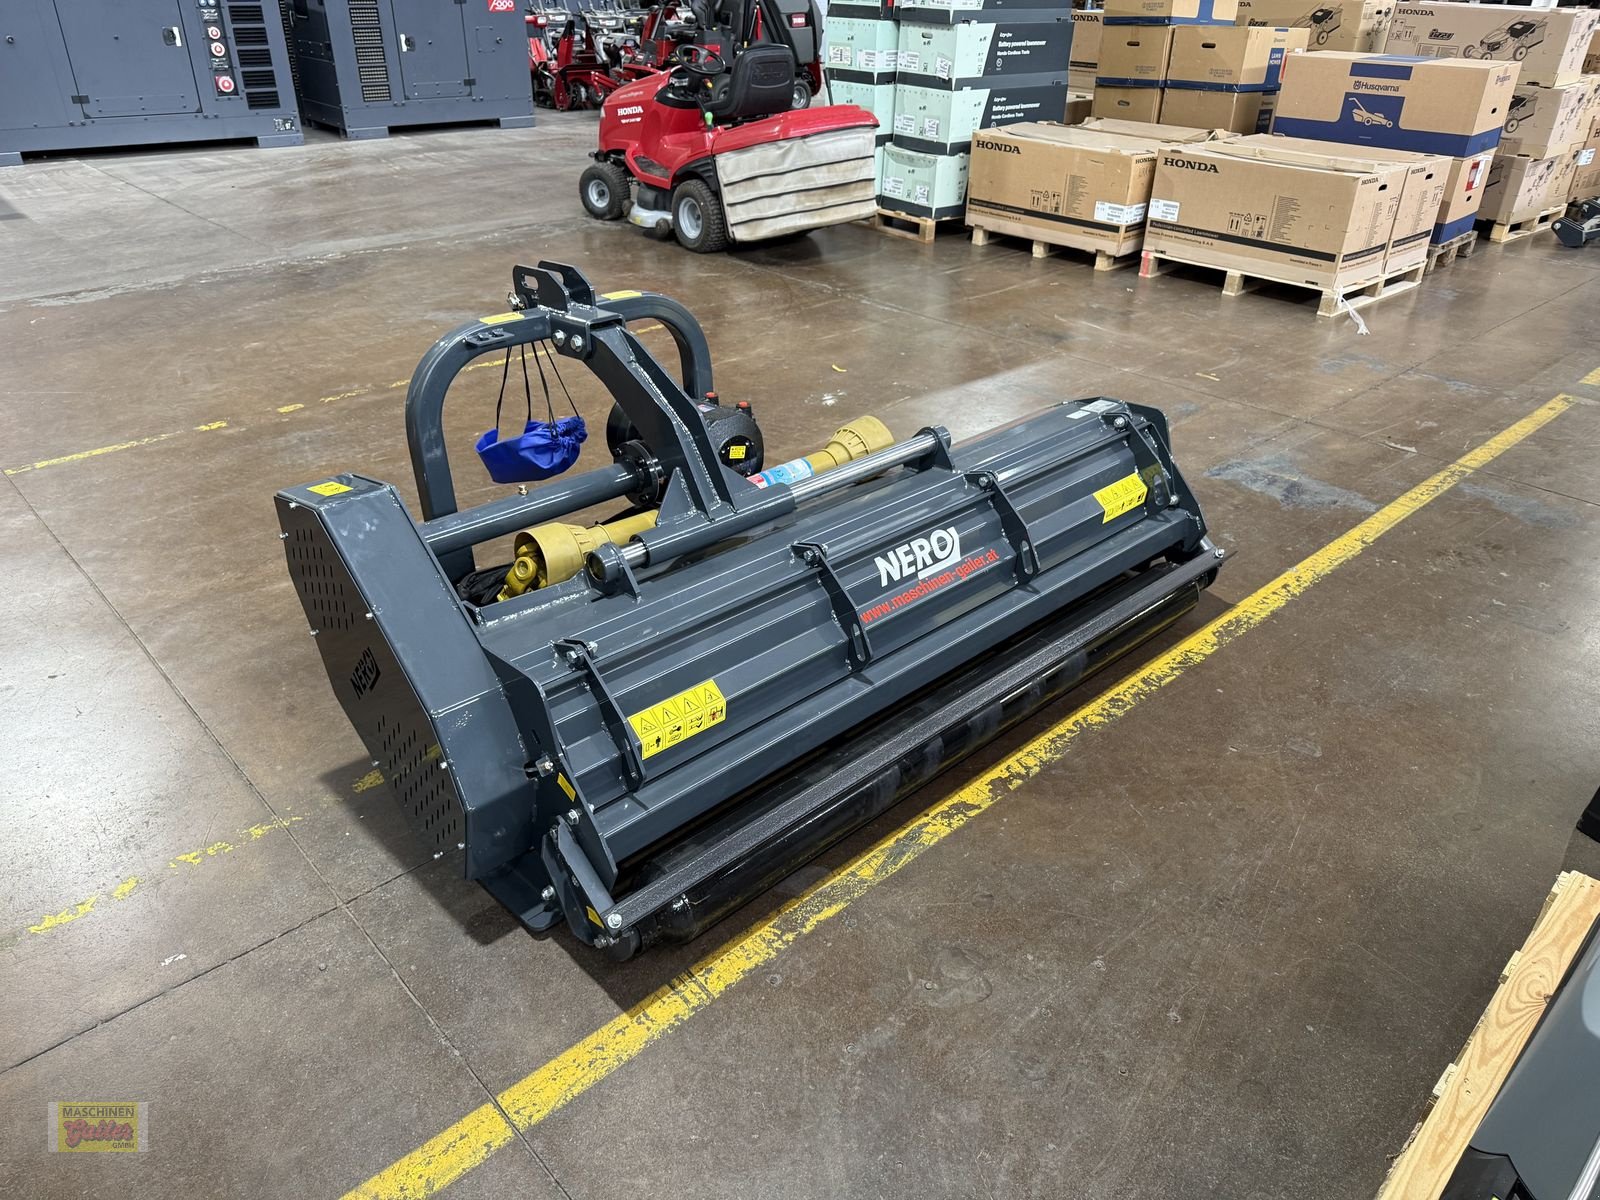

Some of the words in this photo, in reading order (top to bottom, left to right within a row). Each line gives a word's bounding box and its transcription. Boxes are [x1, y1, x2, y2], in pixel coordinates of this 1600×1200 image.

[1398, 9, 1435, 17] HONDA
[1360, 81, 1400, 92] Husqvarna
[617, 105, 644, 117] HONDA
[976, 139, 1022, 155] HONDA
[1135, 156, 1156, 164] HONDA
[1163, 157, 1219, 174] HONDA
[1411, 166, 1426, 175] HONDA
[1361, 177, 1379, 186] HONDA
[874, 528, 959, 587] NERO
[860, 548, 1000, 624] www.maschinen-gailer.at
[350, 647, 379, 700] NERO
